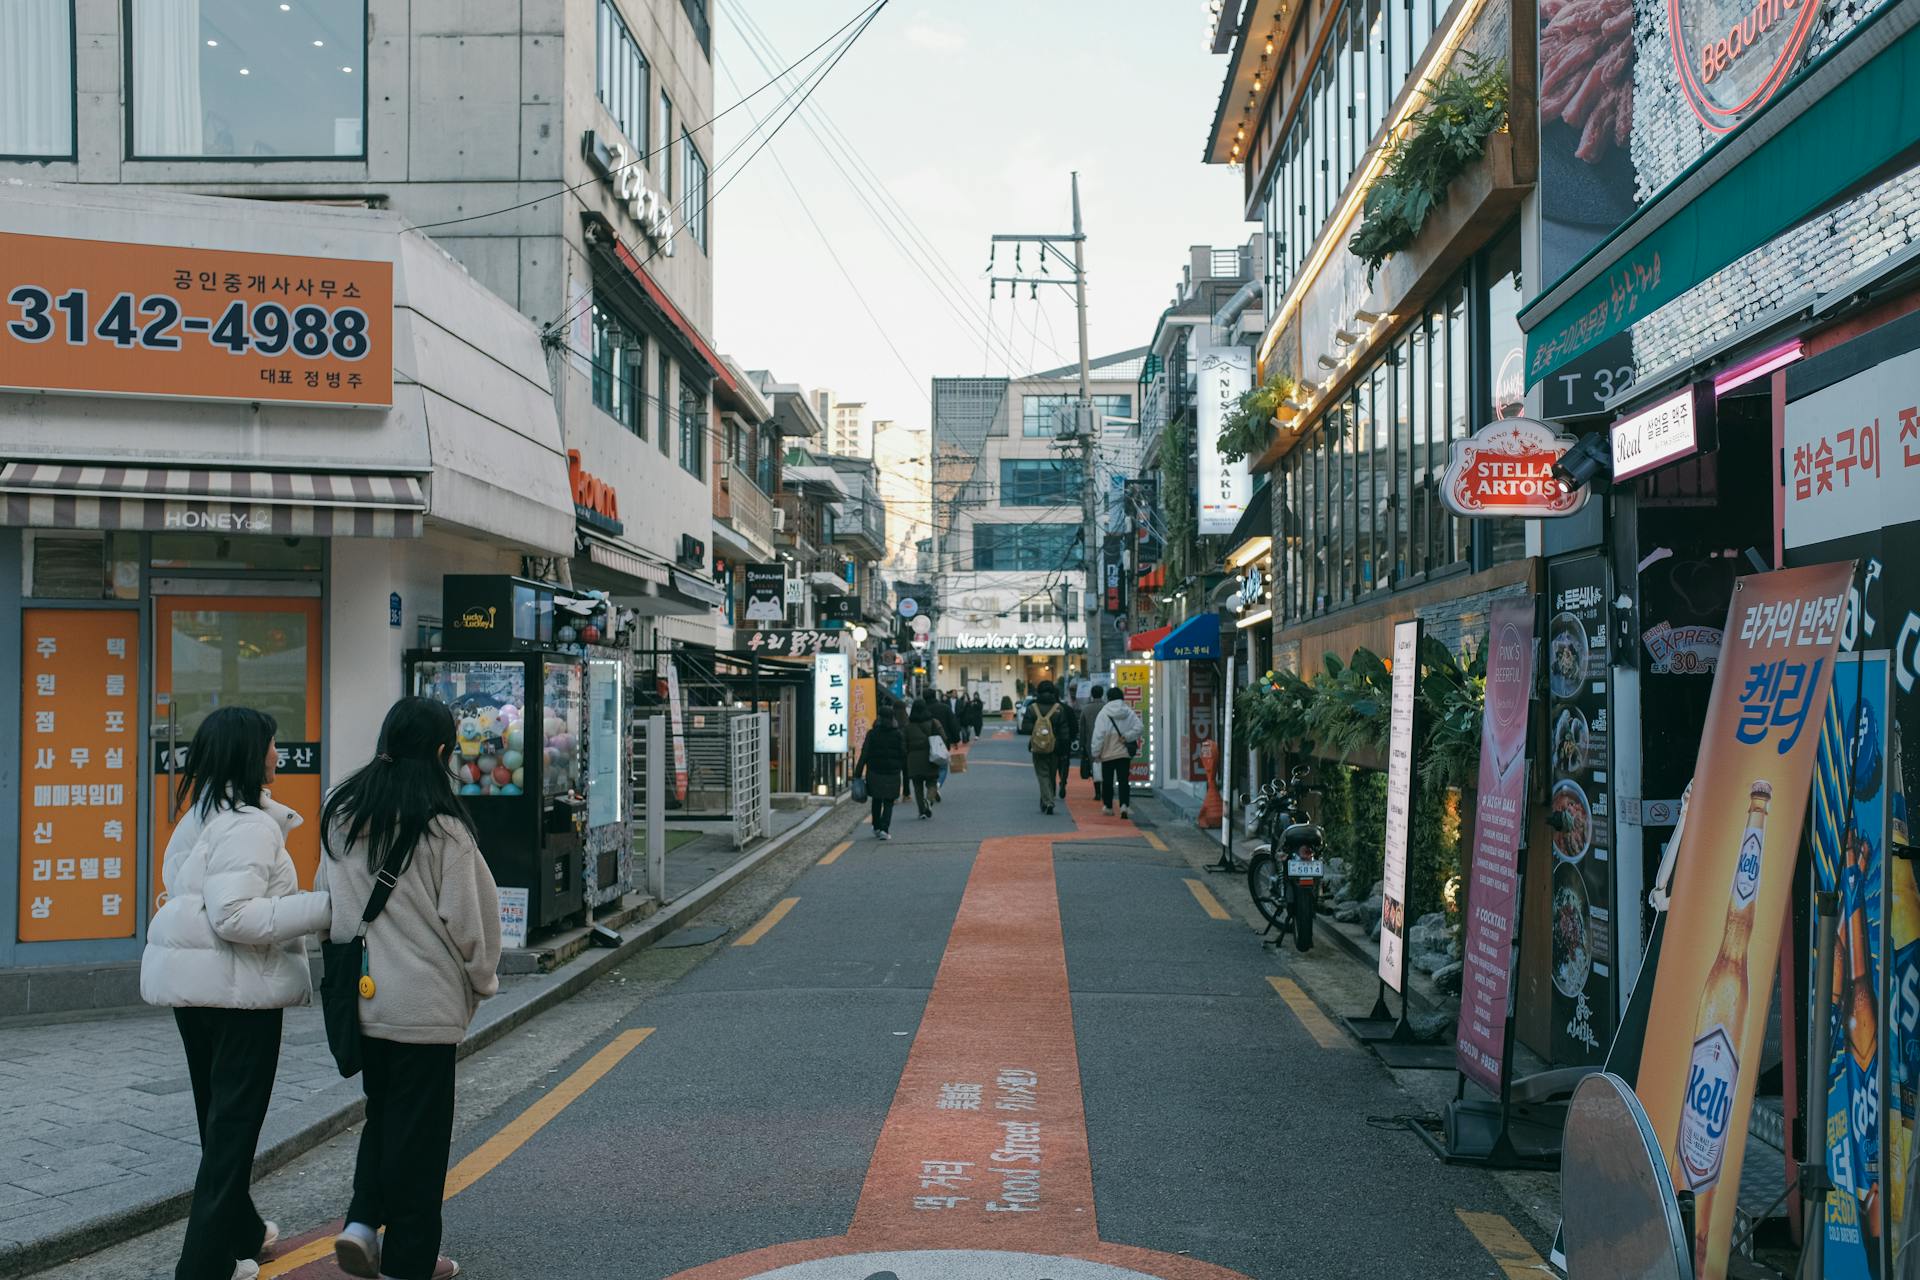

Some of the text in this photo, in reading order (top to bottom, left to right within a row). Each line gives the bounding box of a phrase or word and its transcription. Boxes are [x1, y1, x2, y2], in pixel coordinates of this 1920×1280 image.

[173, 269, 362, 299] 공인중개사사무소
[8, 285, 370, 361] 3142-4988
[260, 368, 363, 389] 대표 정병주
[1558, 372, 1582, 405] T
[1647, 412, 1669, 440] 살얼음
[1672, 404, 1688, 428] 맥주
[1617, 425, 1642, 463] Real
[1793, 418, 1880, 501] 참숯구이
[1477, 461, 1553, 479] STELLA
[1476, 480, 1556, 496] ARTOIS
[165, 510, 247, 529] HONEY
[1740, 594, 1843, 649] 라거의 반전
[747, 632, 785, 651] 우리
[1023, 632, 1067, 649] Bagel
[1650, 630, 1721, 660] EXPRES
[827, 674, 847, 737] 드루와
[1736, 657, 1825, 755] 켈리
[33, 784, 123, 807] 매매및임대
[32, 857, 122, 881] 리모델링
[1738, 853, 1759, 881] Kelly
[1686, 1064, 1733, 1139] Kelly
[1852, 1076, 1879, 1144] Cas
[986, 1120, 1041, 1212] Food Street
